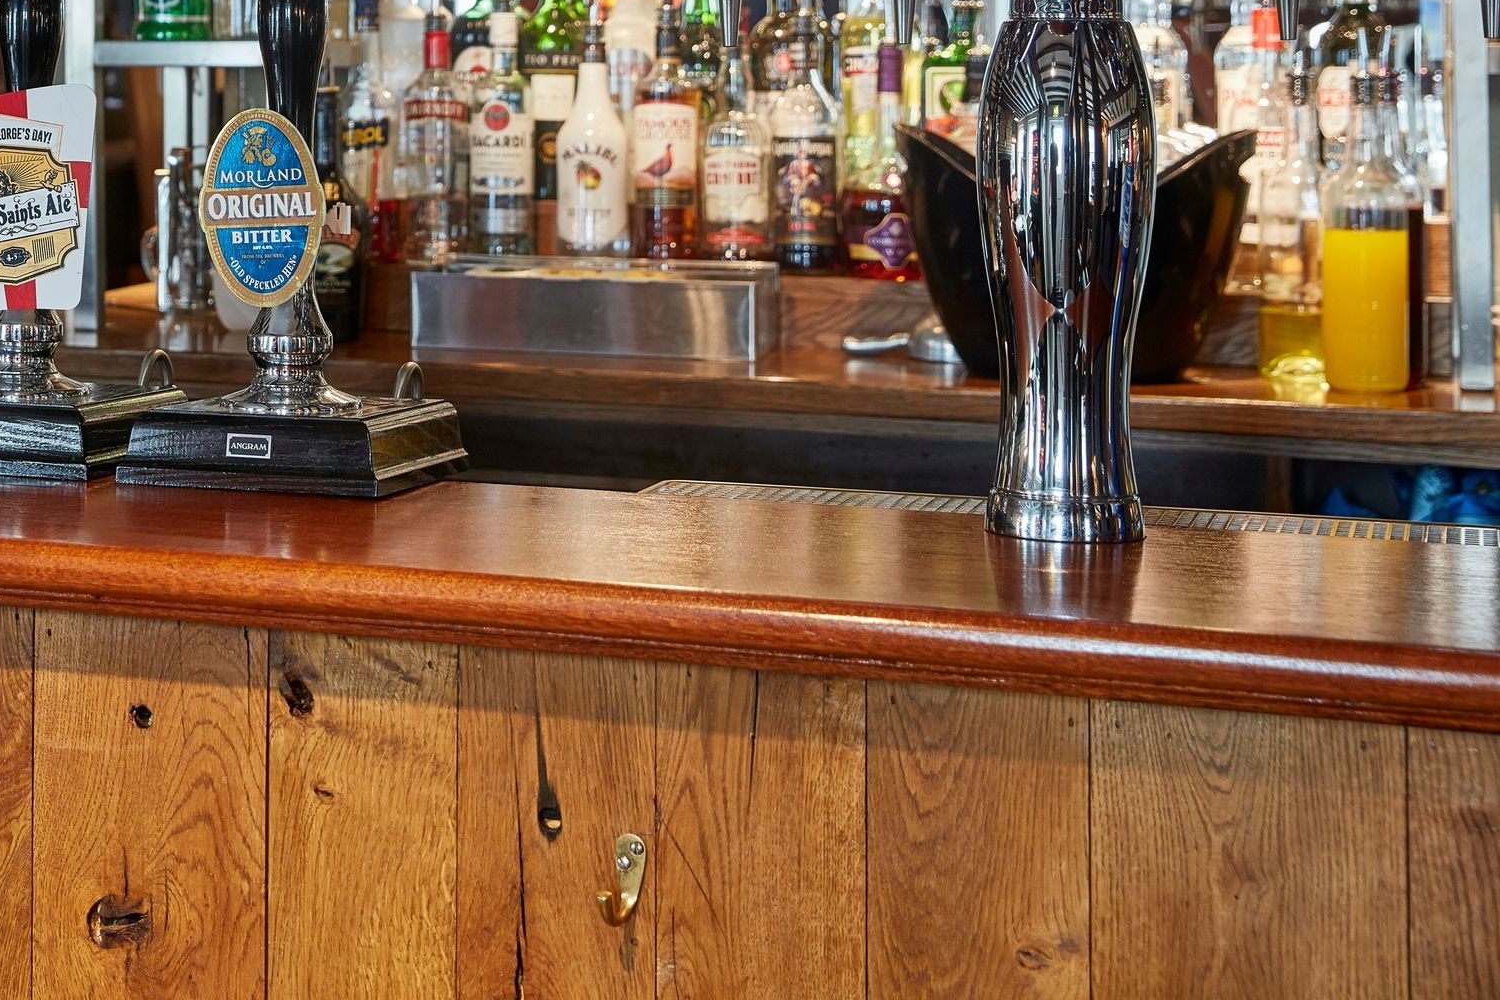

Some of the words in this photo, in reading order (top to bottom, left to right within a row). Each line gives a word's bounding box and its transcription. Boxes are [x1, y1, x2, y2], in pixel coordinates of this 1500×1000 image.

[31, 129, 52, 144] DAY!
[220, 168, 302, 187] MORLAND
[45, 194, 72, 216] Ale
[208, 192, 317, 220] ORIGINAL
[232, 229, 292, 244] BITTER
[243, 274, 285, 290] SPECKLED
[231, 442, 267, 451] ANGRAM
